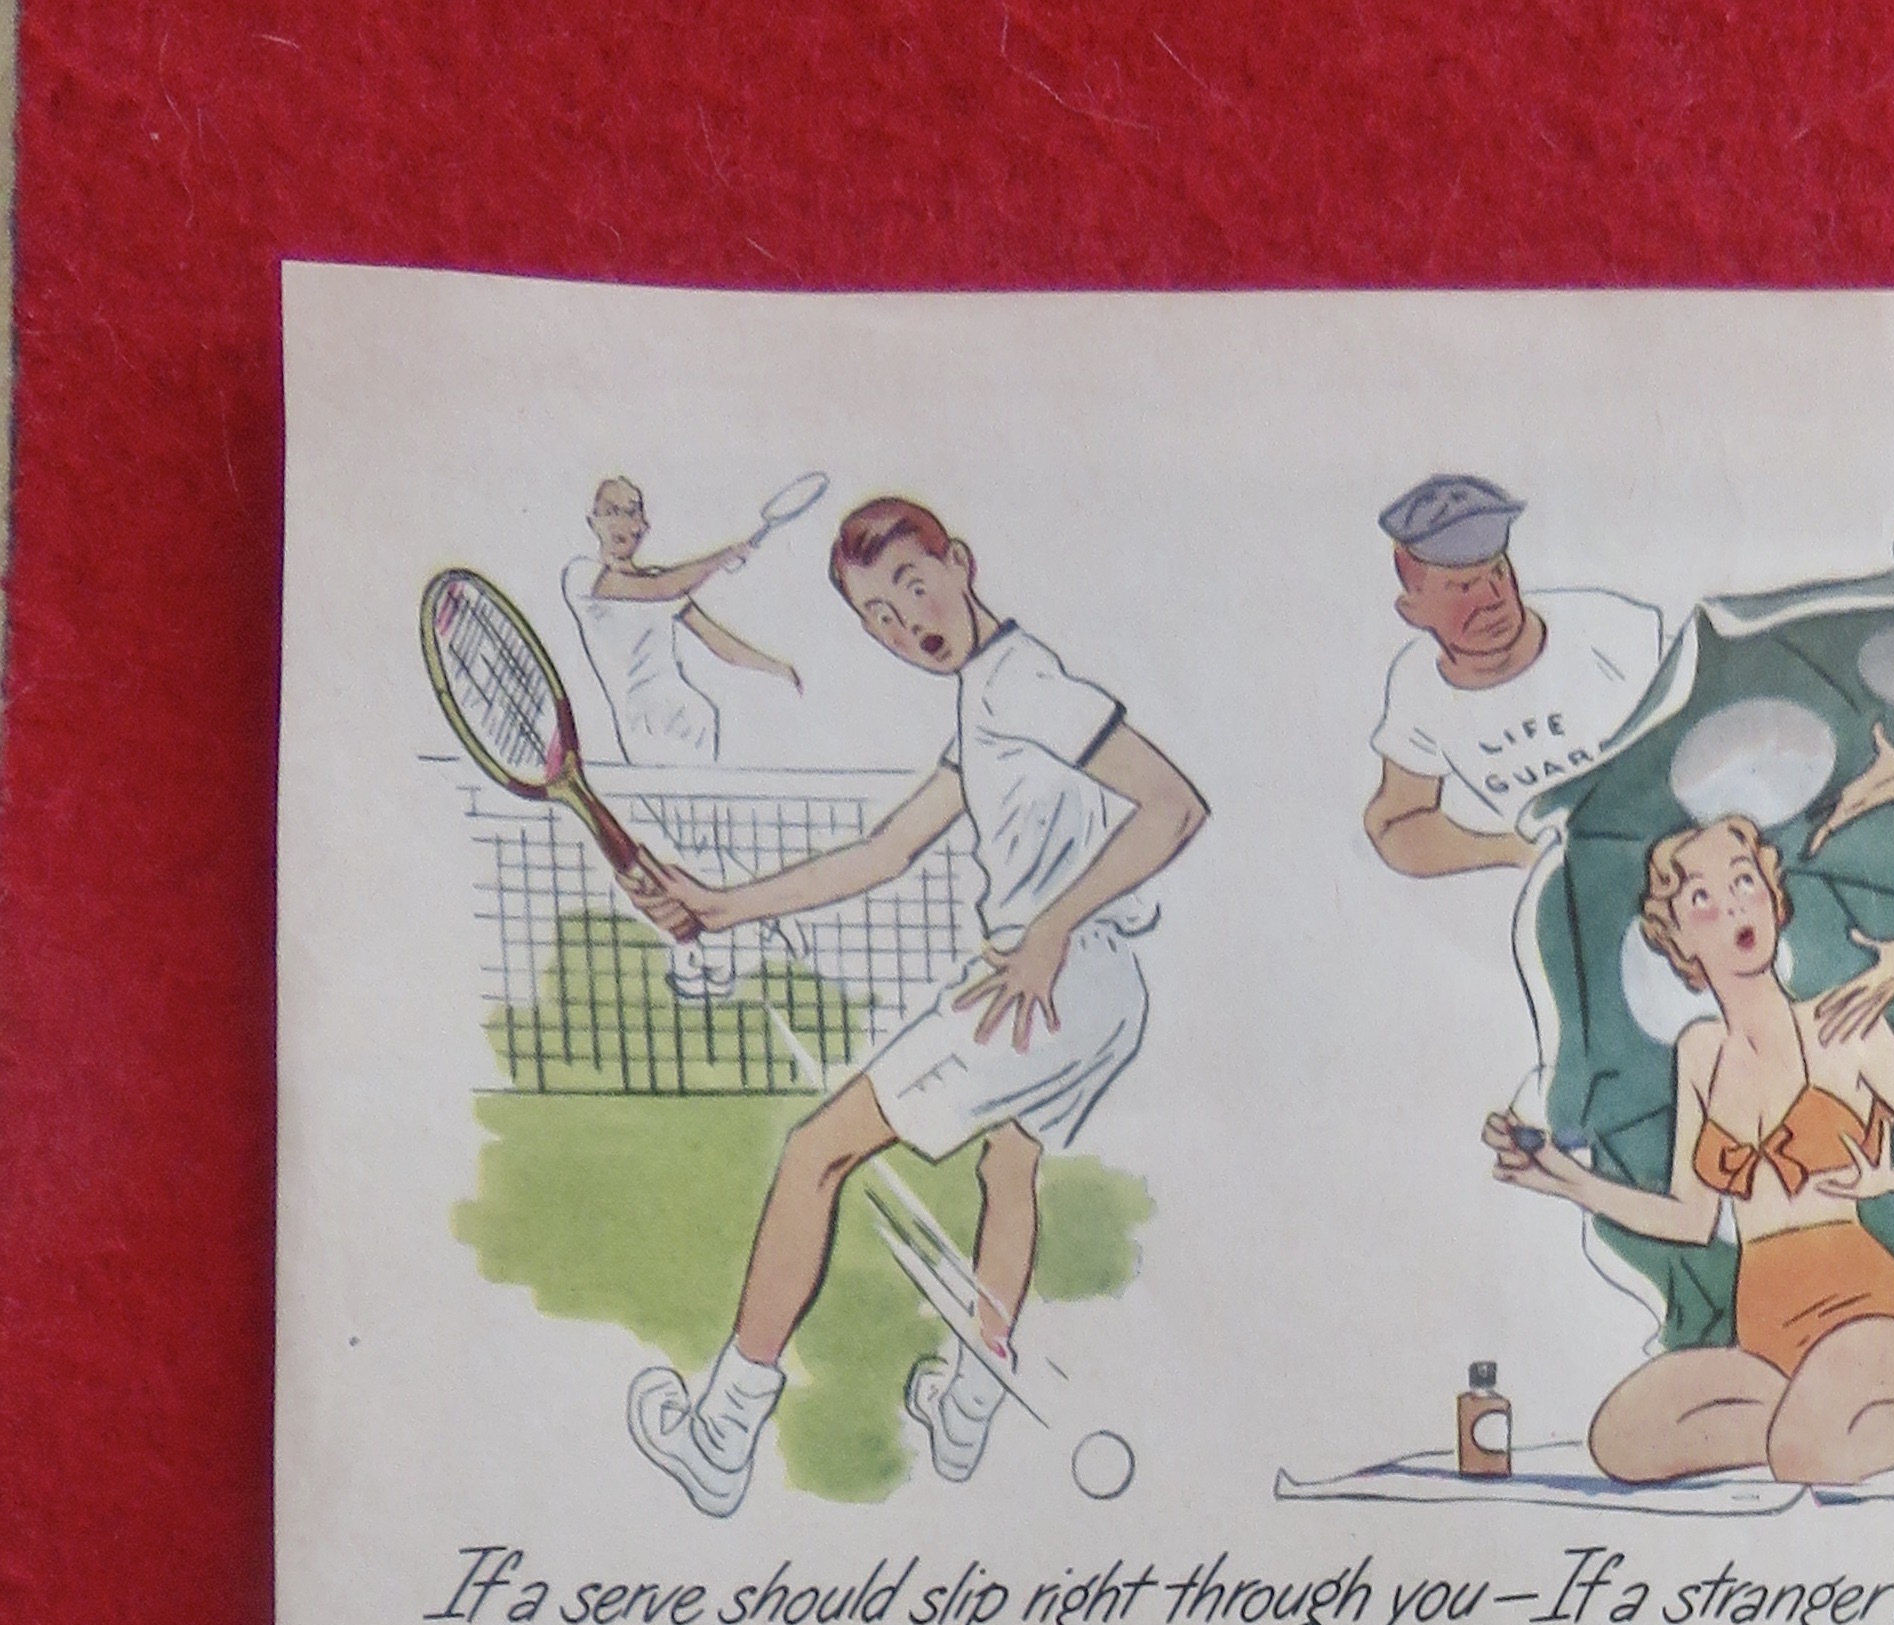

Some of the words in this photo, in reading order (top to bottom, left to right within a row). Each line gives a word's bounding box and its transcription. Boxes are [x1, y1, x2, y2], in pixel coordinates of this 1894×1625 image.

[1478, 713, 1567, 755] LIFE
[1485, 743, 1604, 794] GUAR
[423, 1545, 526, 1625] If
[507, 1580, 550, 1624] a
[1608, 1581, 1651, 1624] a
